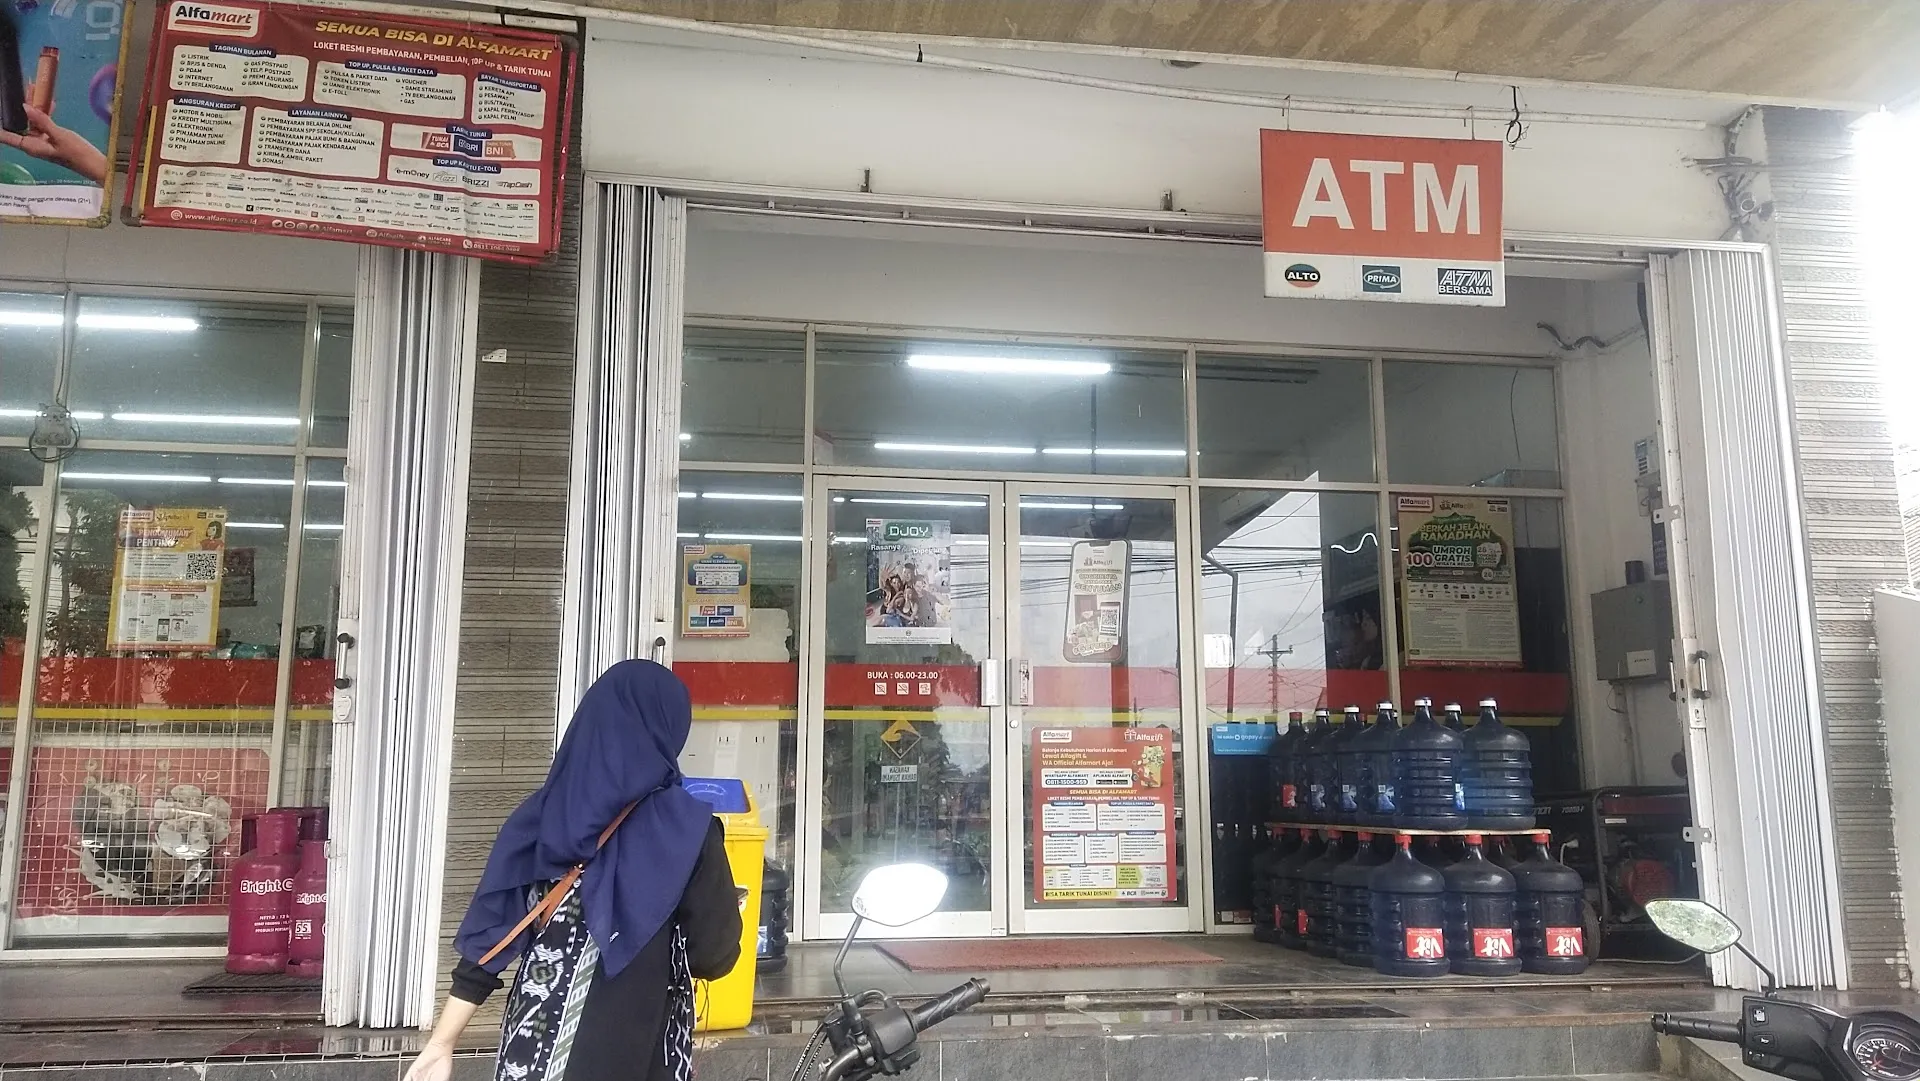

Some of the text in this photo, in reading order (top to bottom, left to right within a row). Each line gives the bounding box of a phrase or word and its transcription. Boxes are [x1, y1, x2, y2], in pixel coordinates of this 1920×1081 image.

[176, 6, 252, 24] Alfamart
[316, 21, 552, 61] SEMUA BISA DI ALFAMART
[214, 45, 271, 56] TAGIHAN BULANAN
[314, 42, 339, 50] LOKET
[340, 44, 365, 53] RESMI
[367, 46, 422, 61] PEMBAYARAN,
[424, 54, 470, 65] PEMBELIAN,
[471, 57, 483, 65] TOP
[504, 65, 527, 75] TARIK
[527, 68, 551, 77] TUNAI
[481, 74, 537, 90] BAYAR TRANSPORTASI
[346, 85, 380, 94] ELEKTRONIK
[413, 93, 456, 101] BERLANGGANAN
[179, 98, 214, 107] ANGSURAN
[267, 117, 305, 126] PEMBAYARAN
[177, 123, 213, 132] ELEKTRONIK
[267, 124, 304, 133] PEMBAYARAN
[316, 129, 365, 137] SEKOLAH/KULIAH
[452, 126, 468, 135] TARIK
[176, 130, 206, 138] PINJAMAN
[266, 131, 304, 140] PEMBAYARAN
[344, 138, 375, 146] BANGUNAN
[175, 137, 206, 145] PINJAMAN
[265, 137, 303, 147] PEMBAYARAN
[264, 144, 294, 153] TRANSFER
[467, 143, 478, 151] BRI
[486, 147, 504, 155] BNI
[462, 176, 489, 187] BRIZZI
[1292, 157, 1480, 235] ATM
[185, 213, 257, 225] www.alfamart.co.id
[322, 226, 352, 234] Alfamart
[1287, 272, 1319, 281] ALTO
[1367, 275, 1397, 283] PRIMA
[1439, 270, 1491, 287] ATM
[1438, 285, 1492, 294] BERSAMA
[890, 526, 929, 537] DJOY
[1420, 524, 1456, 532] BERKAH
[1420, 531, 1490, 540] RAMADHAN
[871, 544, 901, 552] Rasanya
[1433, 546, 1471, 554] UMROH
[1405, 552, 1432, 566] 100
[1434, 555, 1471, 563] GRATIS
[894, 671, 938, 679] 06.00-23.00
[1136, 733, 1163, 741] Alfagift
[241, 879, 282, 895] Bright
[1413, 936, 1442, 958] Vit
[1481, 936, 1511, 957] Vit
[1553, 936, 1581, 956] Vit
